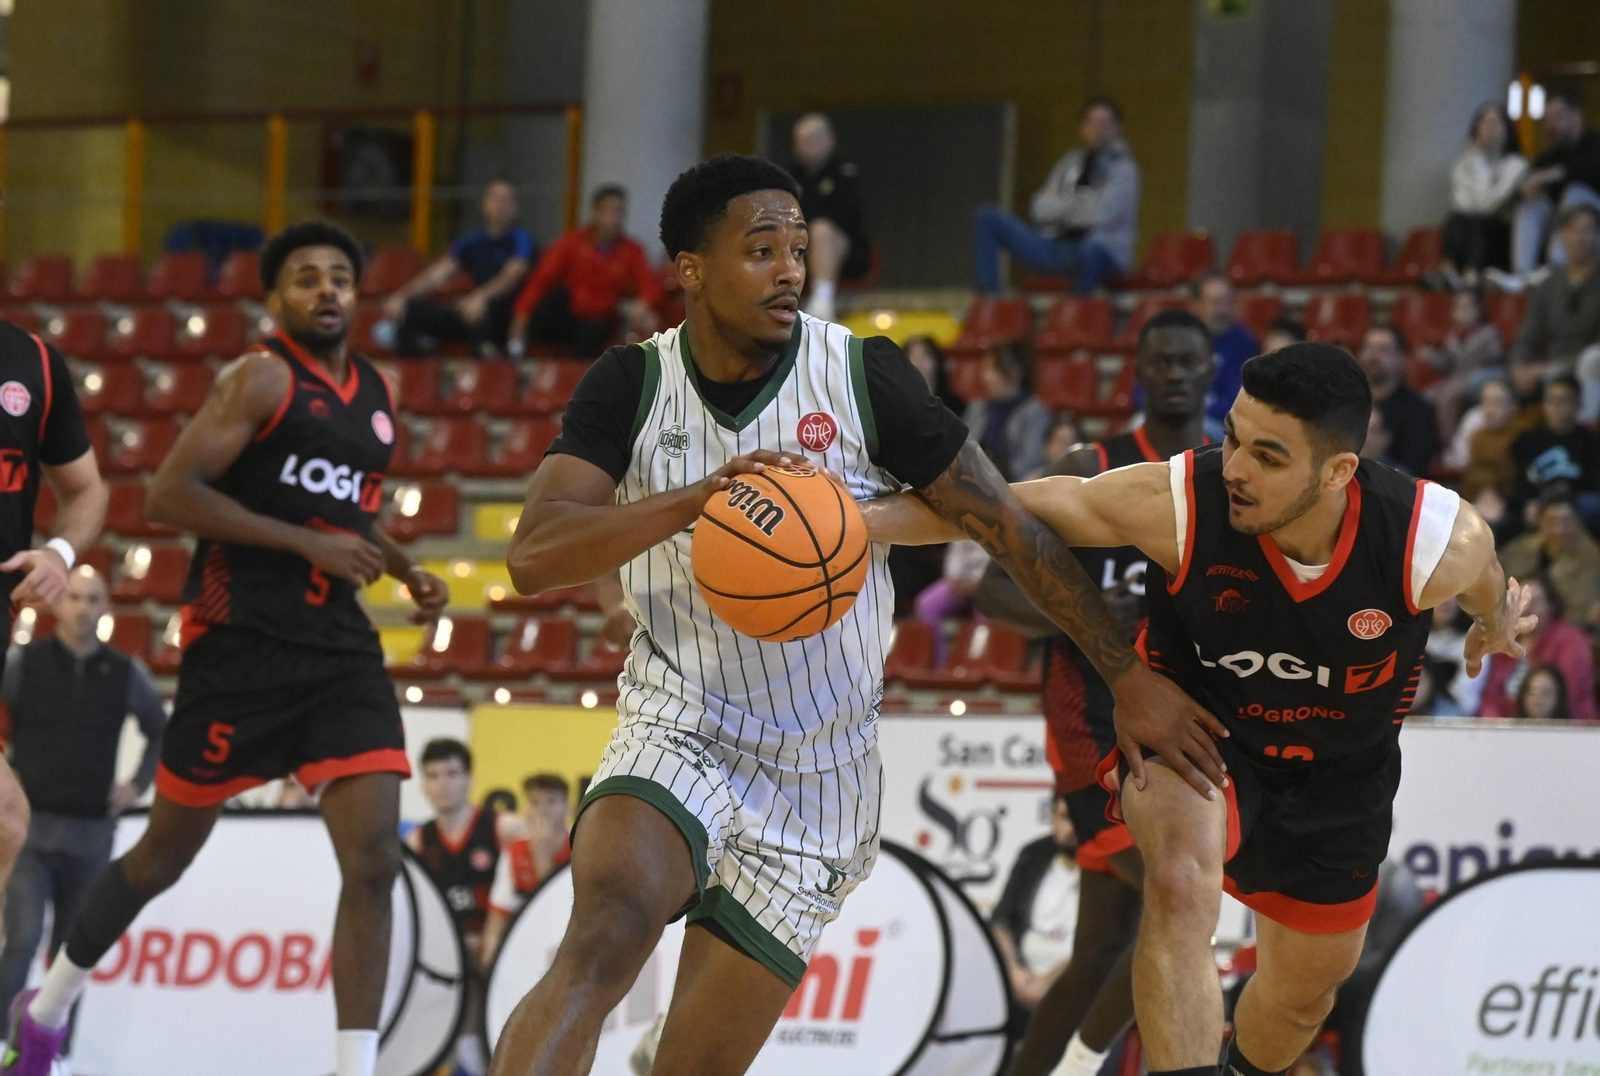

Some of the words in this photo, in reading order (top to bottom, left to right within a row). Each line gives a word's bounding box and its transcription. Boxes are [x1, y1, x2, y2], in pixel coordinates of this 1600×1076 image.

[279, 453, 364, 504] LOGI
[1193, 640, 1331, 688] LOGI
[202, 721, 236, 765] 5
[88, 928, 332, 992] ORDOB
